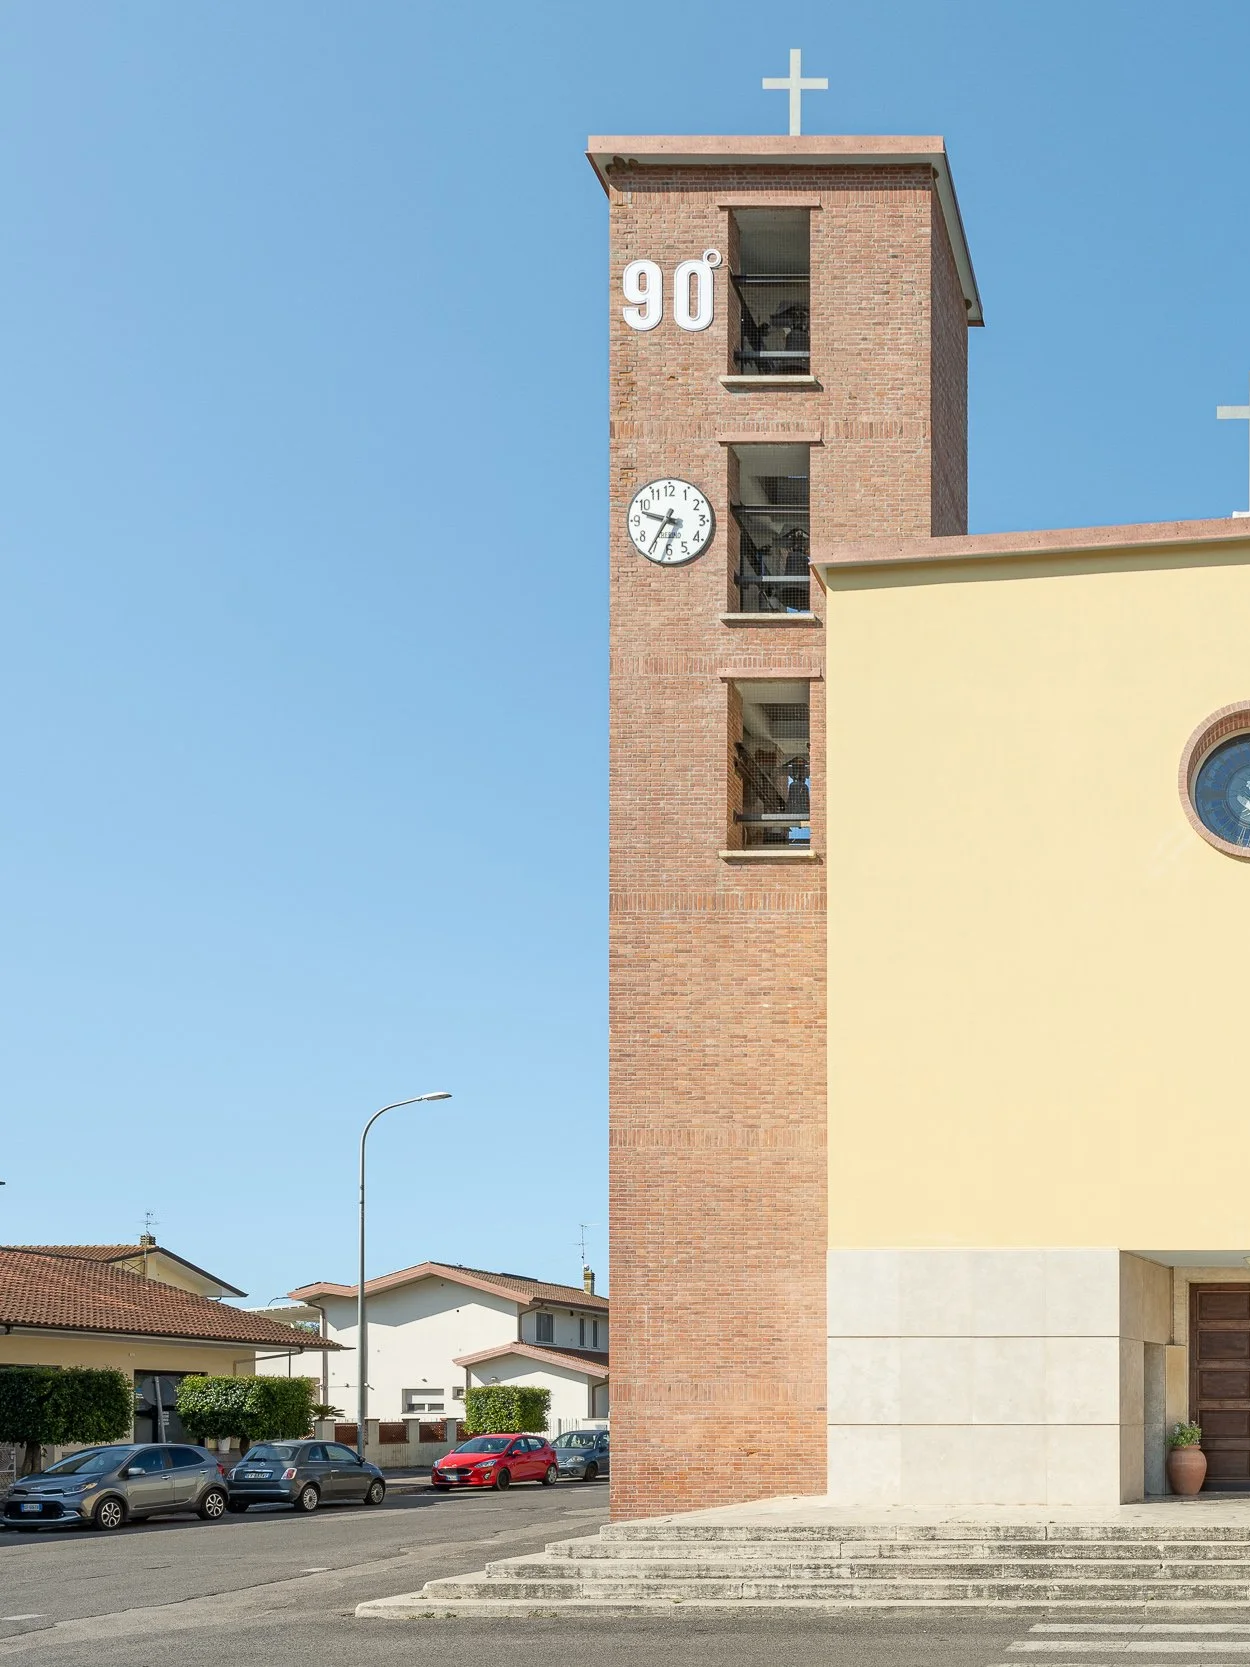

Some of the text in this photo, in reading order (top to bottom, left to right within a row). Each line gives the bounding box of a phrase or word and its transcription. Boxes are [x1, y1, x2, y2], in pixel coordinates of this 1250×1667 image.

[651, 489, 660, 500] 11
[664, 485, 675, 497] 12
[683, 489, 687, 500] 1
[639, 499, 651, 510] 10
[693, 499, 700, 511] 2
[633, 515, 641, 527] 9
[699, 515, 706, 526] 3
[640, 530, 646, 542] 8
[693, 530, 700, 542] 4
[665, 544, 672, 556] 6
[681, 541, 688, 553] 5
